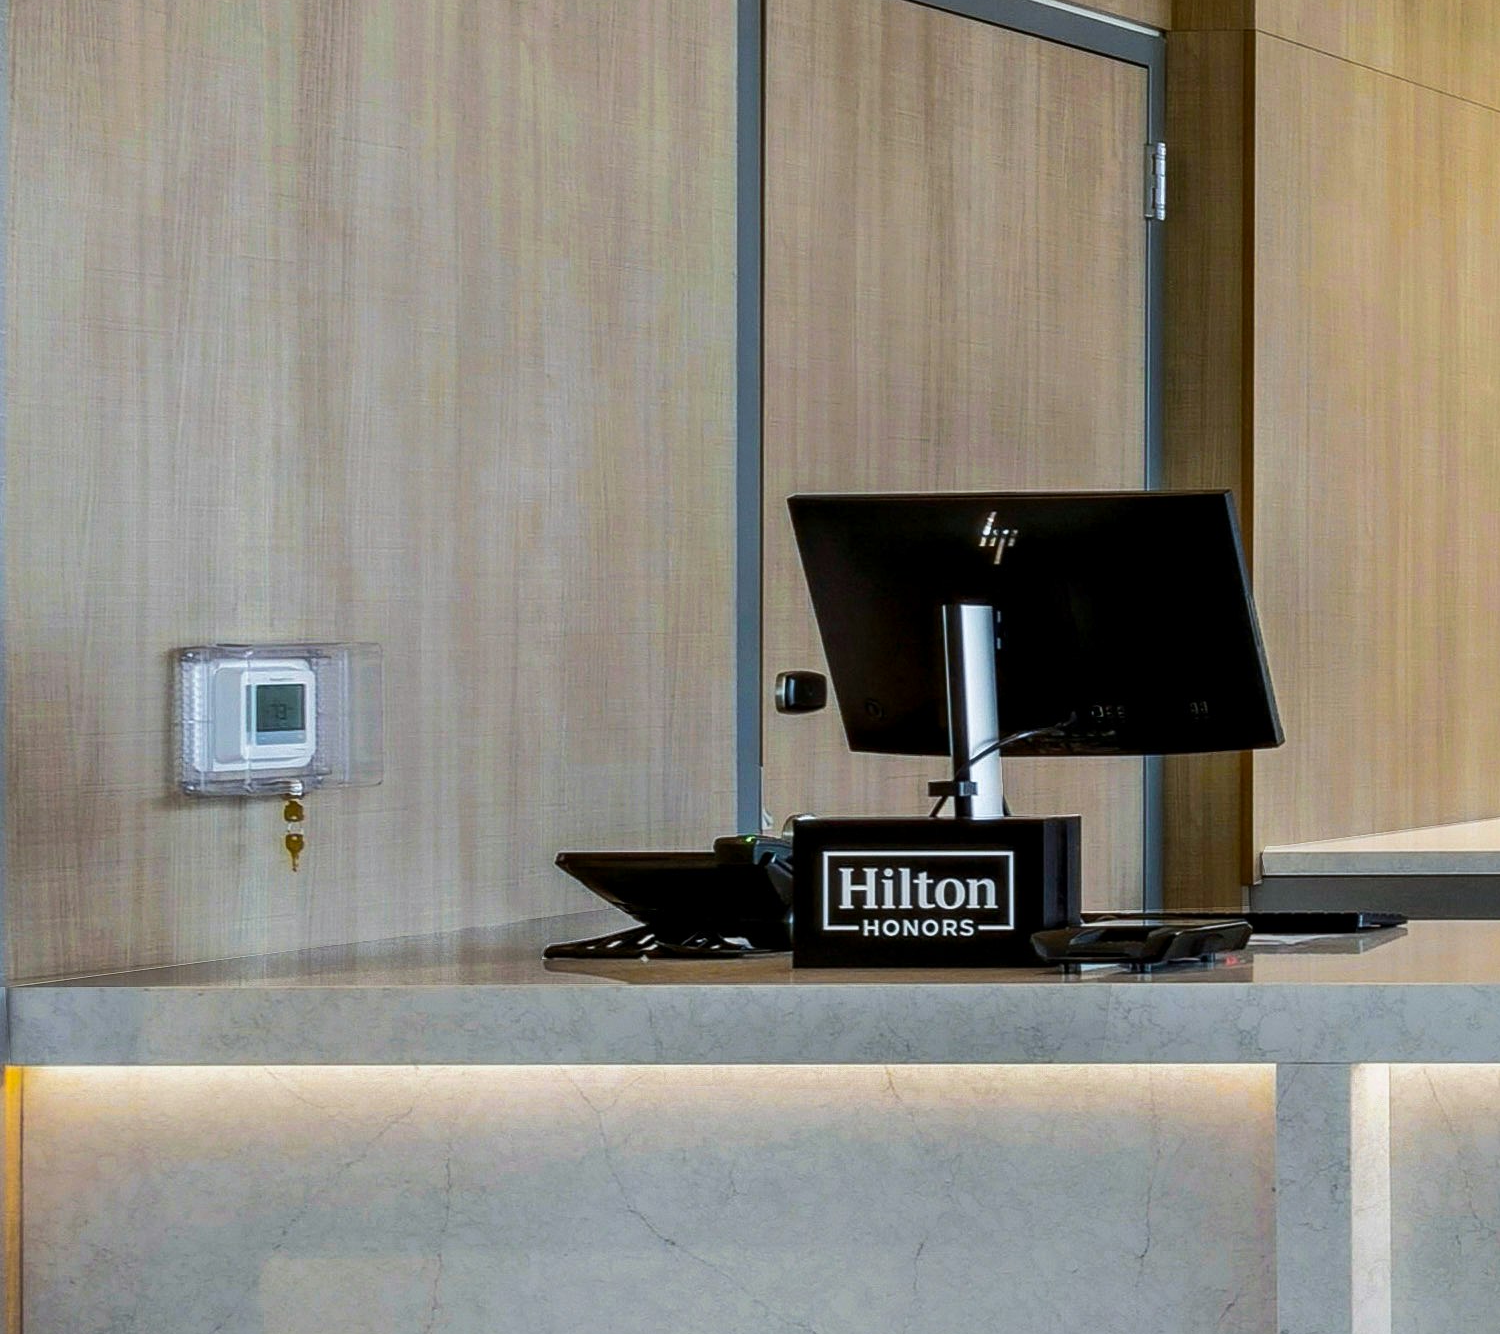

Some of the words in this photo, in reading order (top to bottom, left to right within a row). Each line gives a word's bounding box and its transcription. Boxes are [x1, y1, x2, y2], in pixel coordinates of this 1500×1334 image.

[979, 511, 1019, 565] hp
[839, 868, 999, 910] Hilton
[863, 919, 976, 937] HONORS
